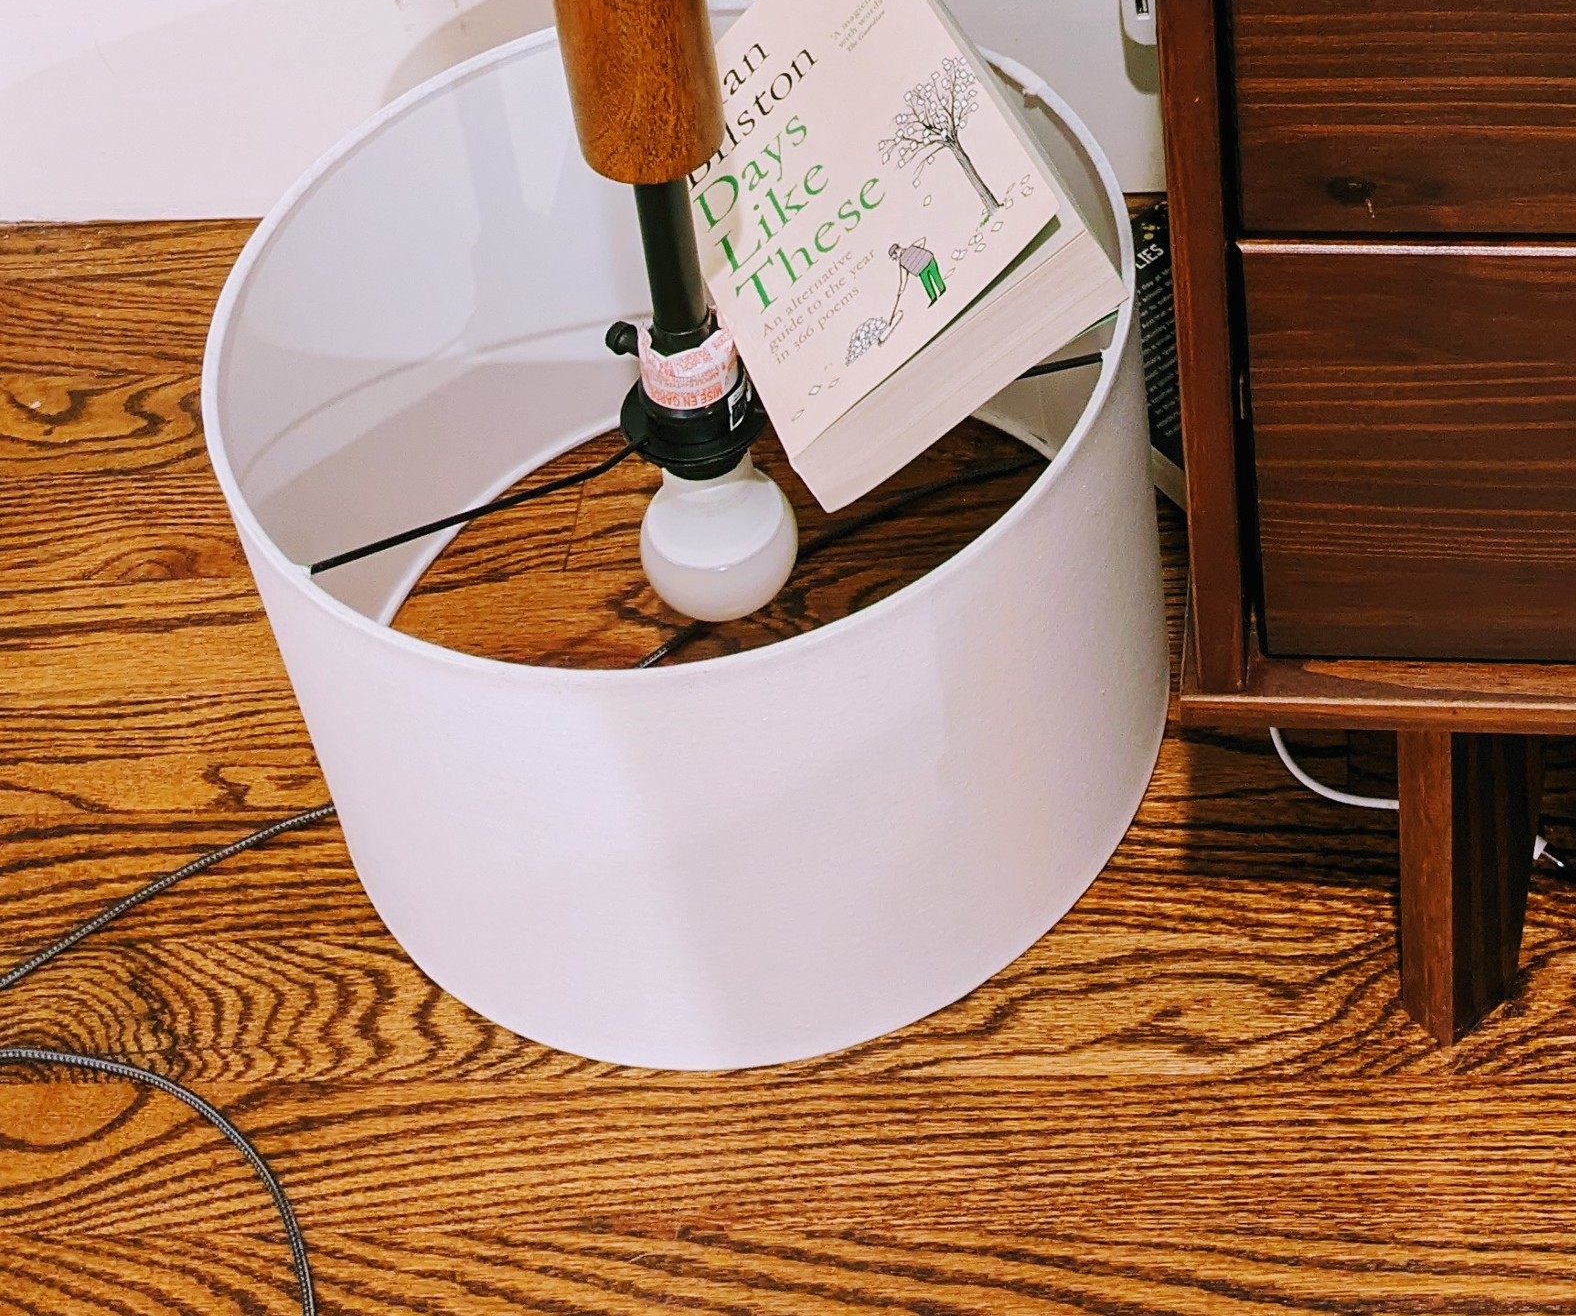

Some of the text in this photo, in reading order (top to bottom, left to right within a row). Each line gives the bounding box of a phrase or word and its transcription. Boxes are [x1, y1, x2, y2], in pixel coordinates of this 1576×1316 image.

[723, 43, 770, 104] an
[839, 27, 858, 48] with
[693, 115, 808, 233] Days
[714, 164, 829, 278] Like
[735, 178, 886, 315] These
[763, 251, 854, 338] An alternative
[769, 249, 876, 354] guide to the year
[775, 286, 860, 364] in 366 poems
[684, 395, 697, 407] EN
